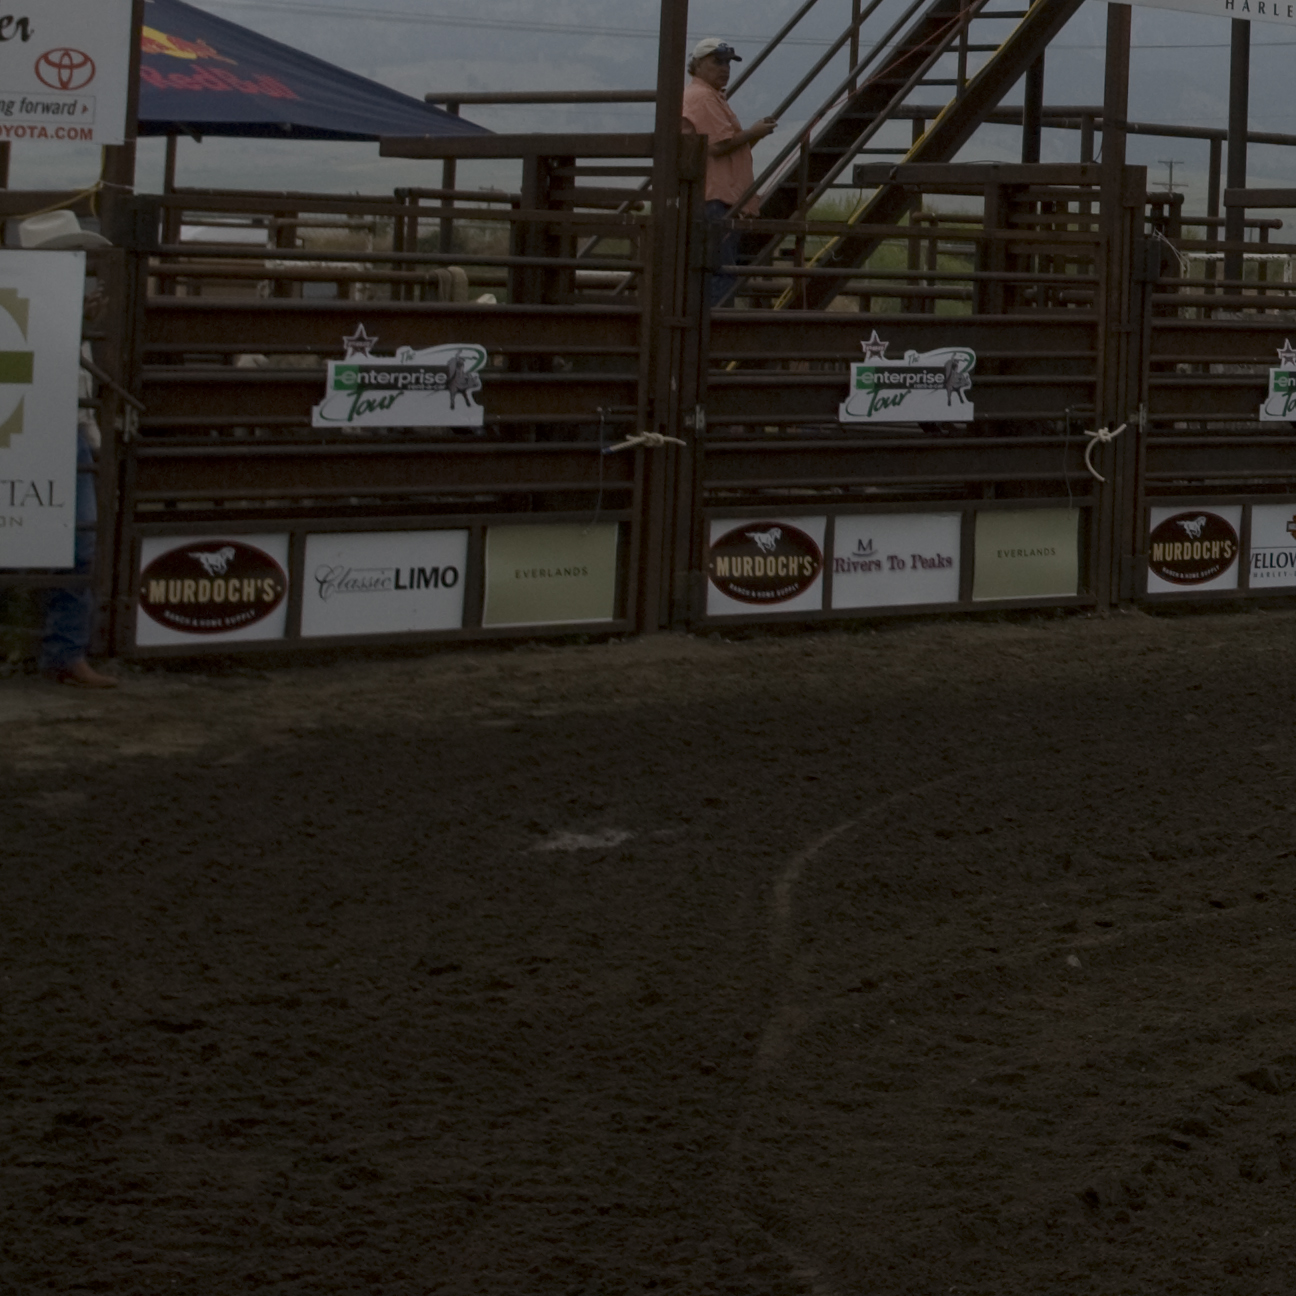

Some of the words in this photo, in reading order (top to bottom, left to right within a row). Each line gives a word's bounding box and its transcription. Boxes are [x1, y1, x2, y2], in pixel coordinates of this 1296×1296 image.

[19, 97, 78, 116] forward
[341, 369, 447, 388] enterprise
[861, 370, 945, 387] enterprise
[335, 389, 404, 422] Tour
[858, 388, 911, 417] Tour
[997, 547, 1056, 559] EVERLANDS
[1152, 539, 1233, 562] MURDOCH'S
[514, 567, 590, 580] EVERLANDS
[716, 555, 814, 577] MURDOCH'S
[834, 557, 881, 574] Rivers
[886, 555, 906, 571] To
[911, 553, 954, 570] Peaks
[394, 566, 460, 590] LIMO
[149, 578, 275, 604] MURDOCH'S
